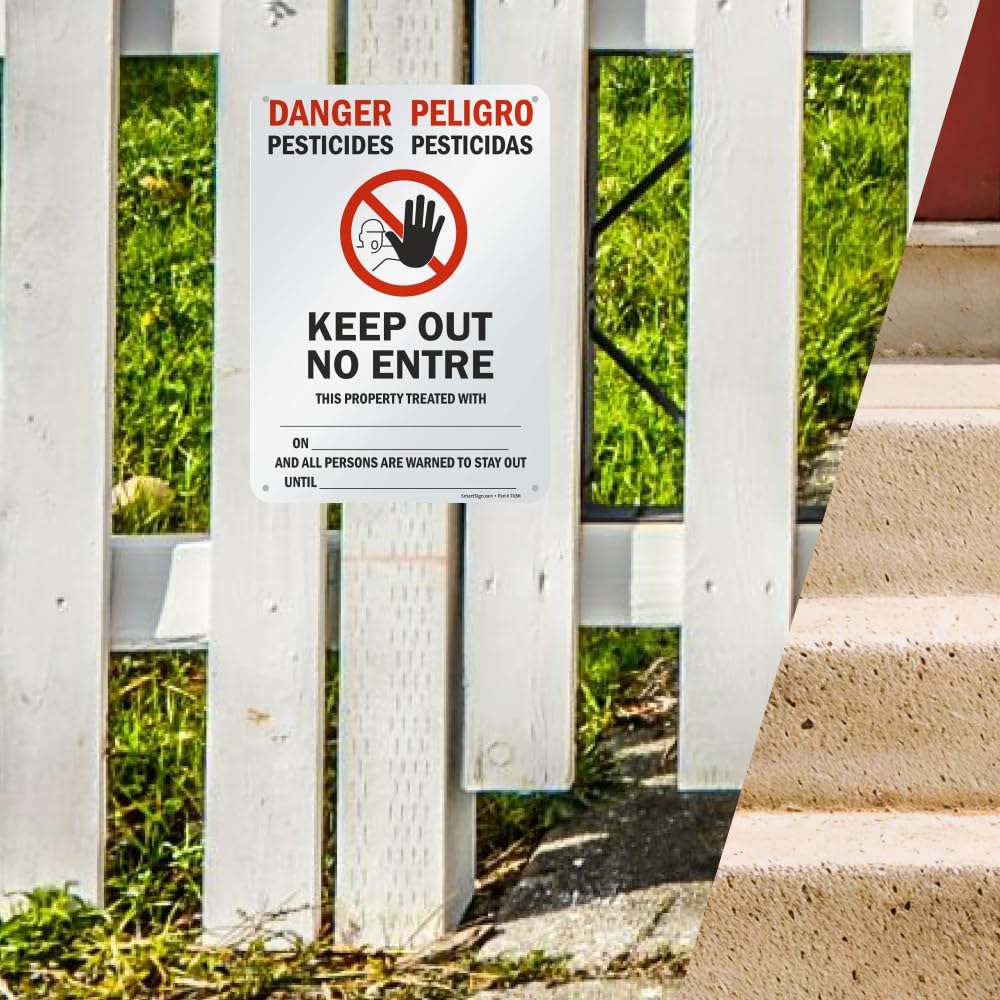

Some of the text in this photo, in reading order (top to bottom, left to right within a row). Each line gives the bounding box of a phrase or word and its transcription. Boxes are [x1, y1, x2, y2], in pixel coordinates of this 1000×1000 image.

[269, 99, 534, 127] DANGER PELIGRO
[267, 134, 533, 156] PESTICIDES PESTICIDAS
[308, 311, 493, 342] KEEP OUT
[307, 349, 494, 380] NO ENTRE
[315, 392, 487, 405] THIS PROPERTY TREATED WITH
[292, 437, 309, 449] ON
[274, 456, 528, 469] AND ALL PERSONS ARE WARNED TO STAY OUT
[284, 476, 318, 488] UNTIL
